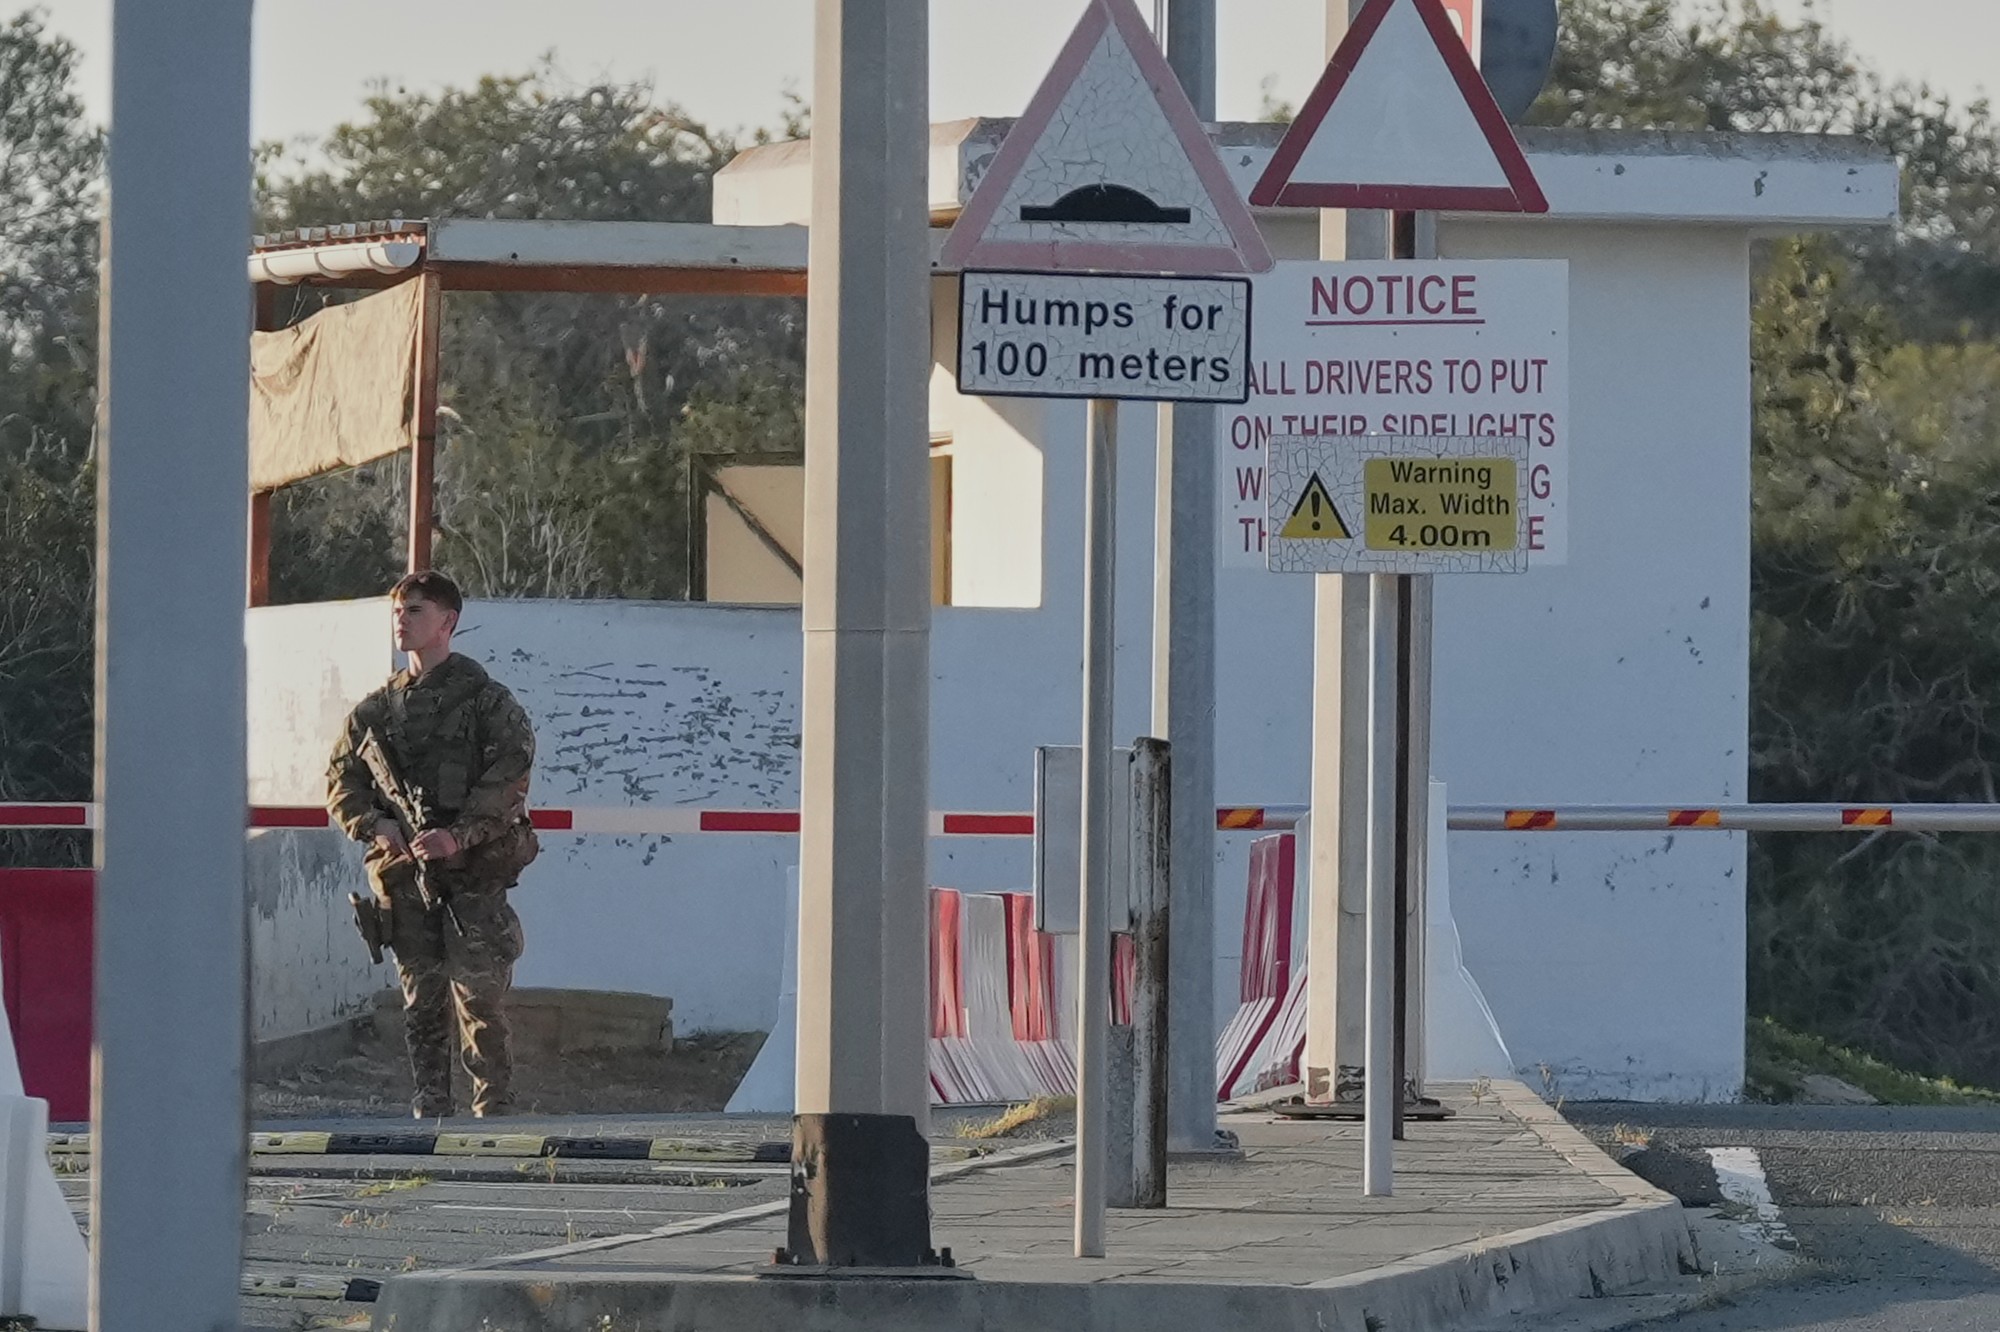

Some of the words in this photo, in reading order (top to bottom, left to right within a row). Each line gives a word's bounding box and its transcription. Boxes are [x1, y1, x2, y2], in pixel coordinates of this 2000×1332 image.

[981, 288, 1134, 335] Humps
[1163, 294, 1223, 331] for
[1311, 275, 1477, 315] NOTICE
[971, 341, 1048, 377] 100
[1079, 347, 1230, 382] meters
[1305, 359, 1433, 395] DRIVERS
[1443, 359, 1482, 394] TO
[1491, 359, 1548, 394] PUT
[1231, 415, 1271, 450] ON
[1390, 461, 1492, 489] Warning
[1370, 493, 1426, 515] Max.
[1440, 493, 1510, 515] Width
[1388, 525, 1491, 547] 4.00m
